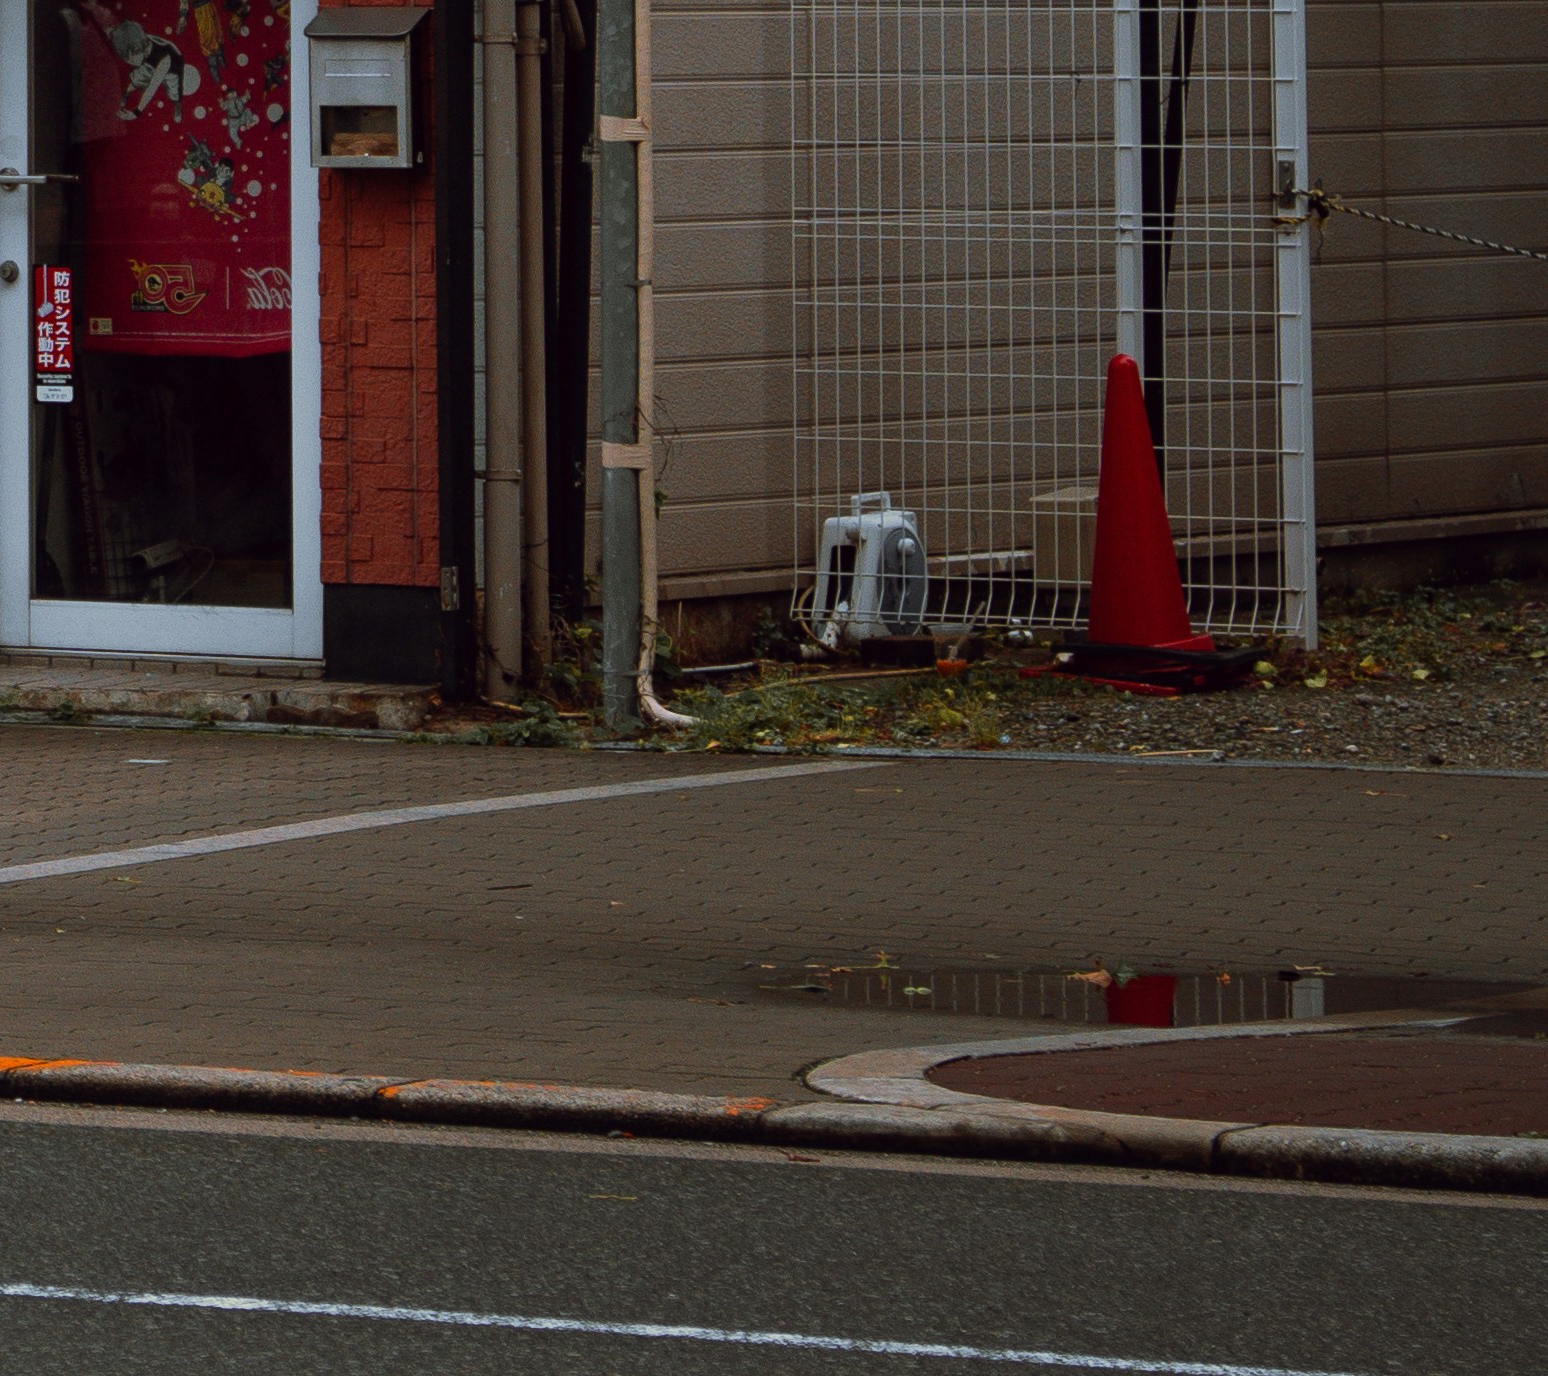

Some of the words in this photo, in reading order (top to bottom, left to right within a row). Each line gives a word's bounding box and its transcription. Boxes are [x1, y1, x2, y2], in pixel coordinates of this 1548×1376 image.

[37, 321, 55, 369] 作動中
[53, 270, 72, 369] 防犯システム
